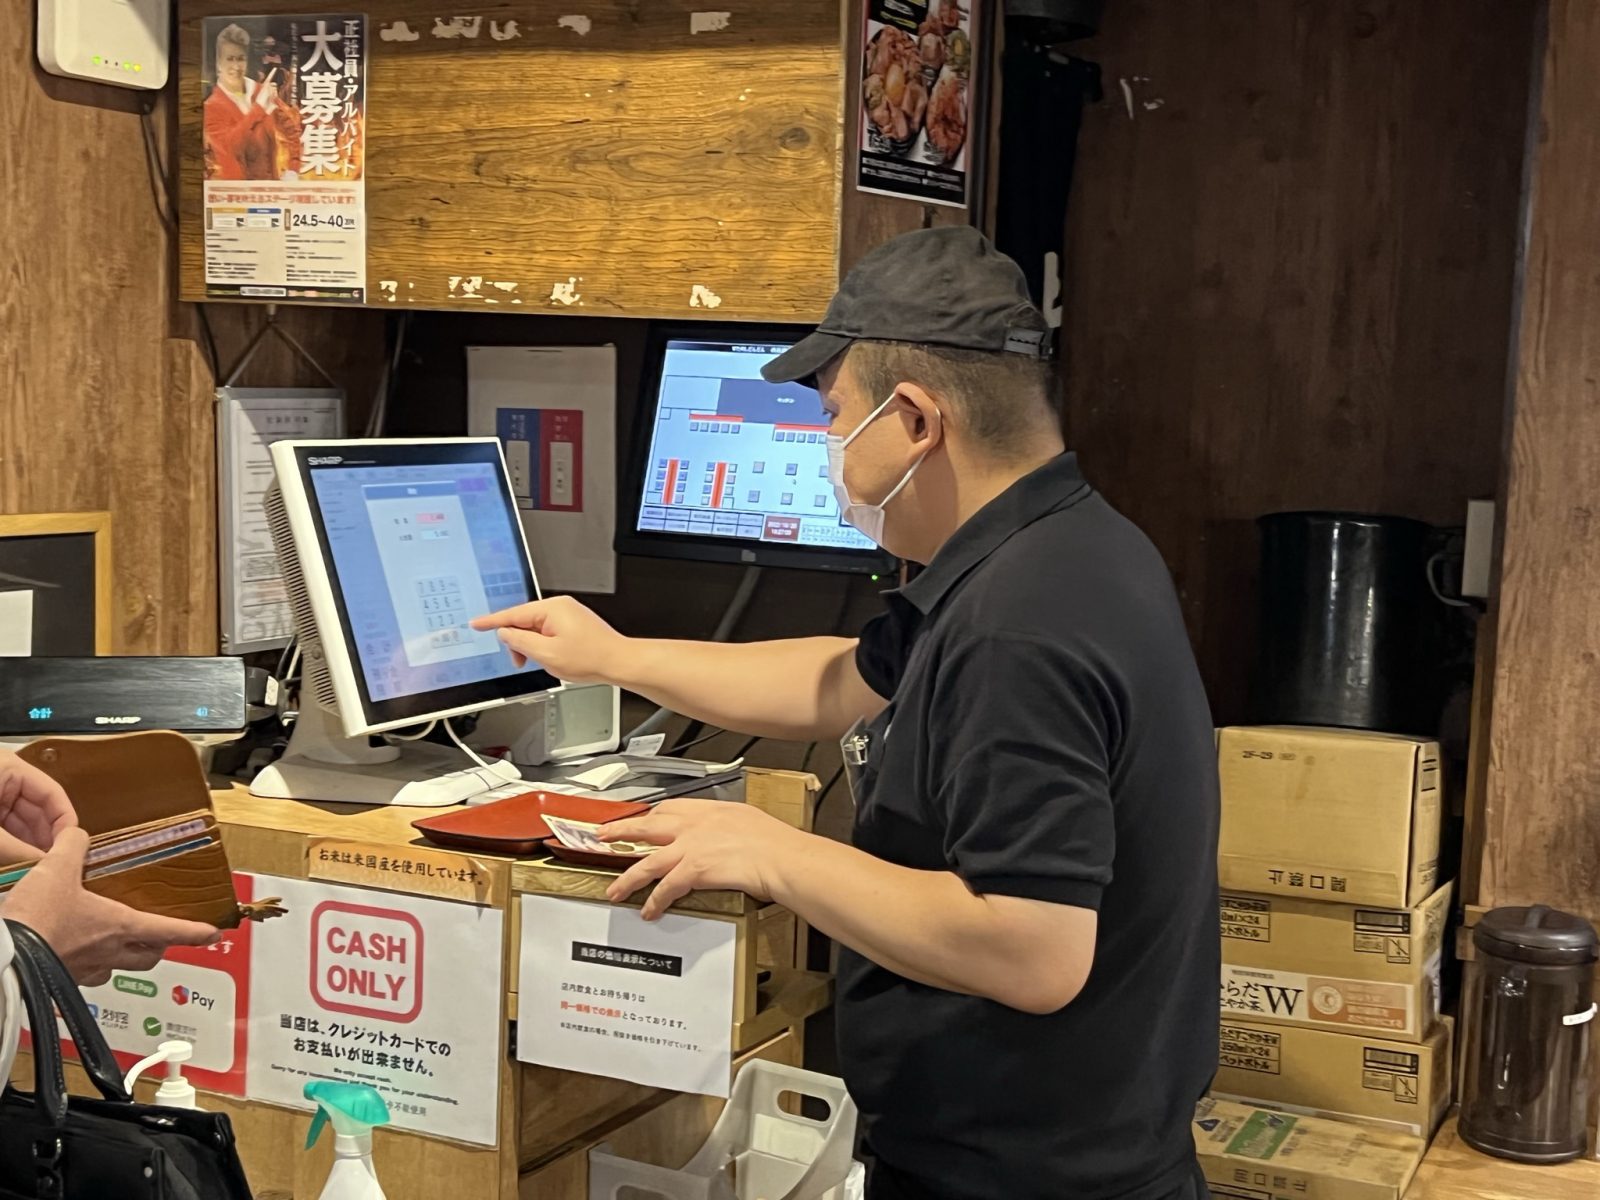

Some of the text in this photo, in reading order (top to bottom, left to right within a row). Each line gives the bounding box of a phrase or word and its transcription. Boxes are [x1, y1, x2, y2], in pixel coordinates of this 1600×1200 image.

[300, 20, 344, 176] 大募集
[342, 20, 361, 176] 正社員・アルバイト
[308, 456, 343, 465] SHARP
[95, 716, 141, 724] SHARP
[327, 926, 406, 964] CASH
[192, 991, 215, 1011] Pay
[326, 965, 406, 1001] ONLY
[1260, 984, 1304, 1016] W
[280, 1013, 451, 1056] 当店は、クレジットカードでの
[293, 1037, 434, 1077] お支払いが出来ません。
